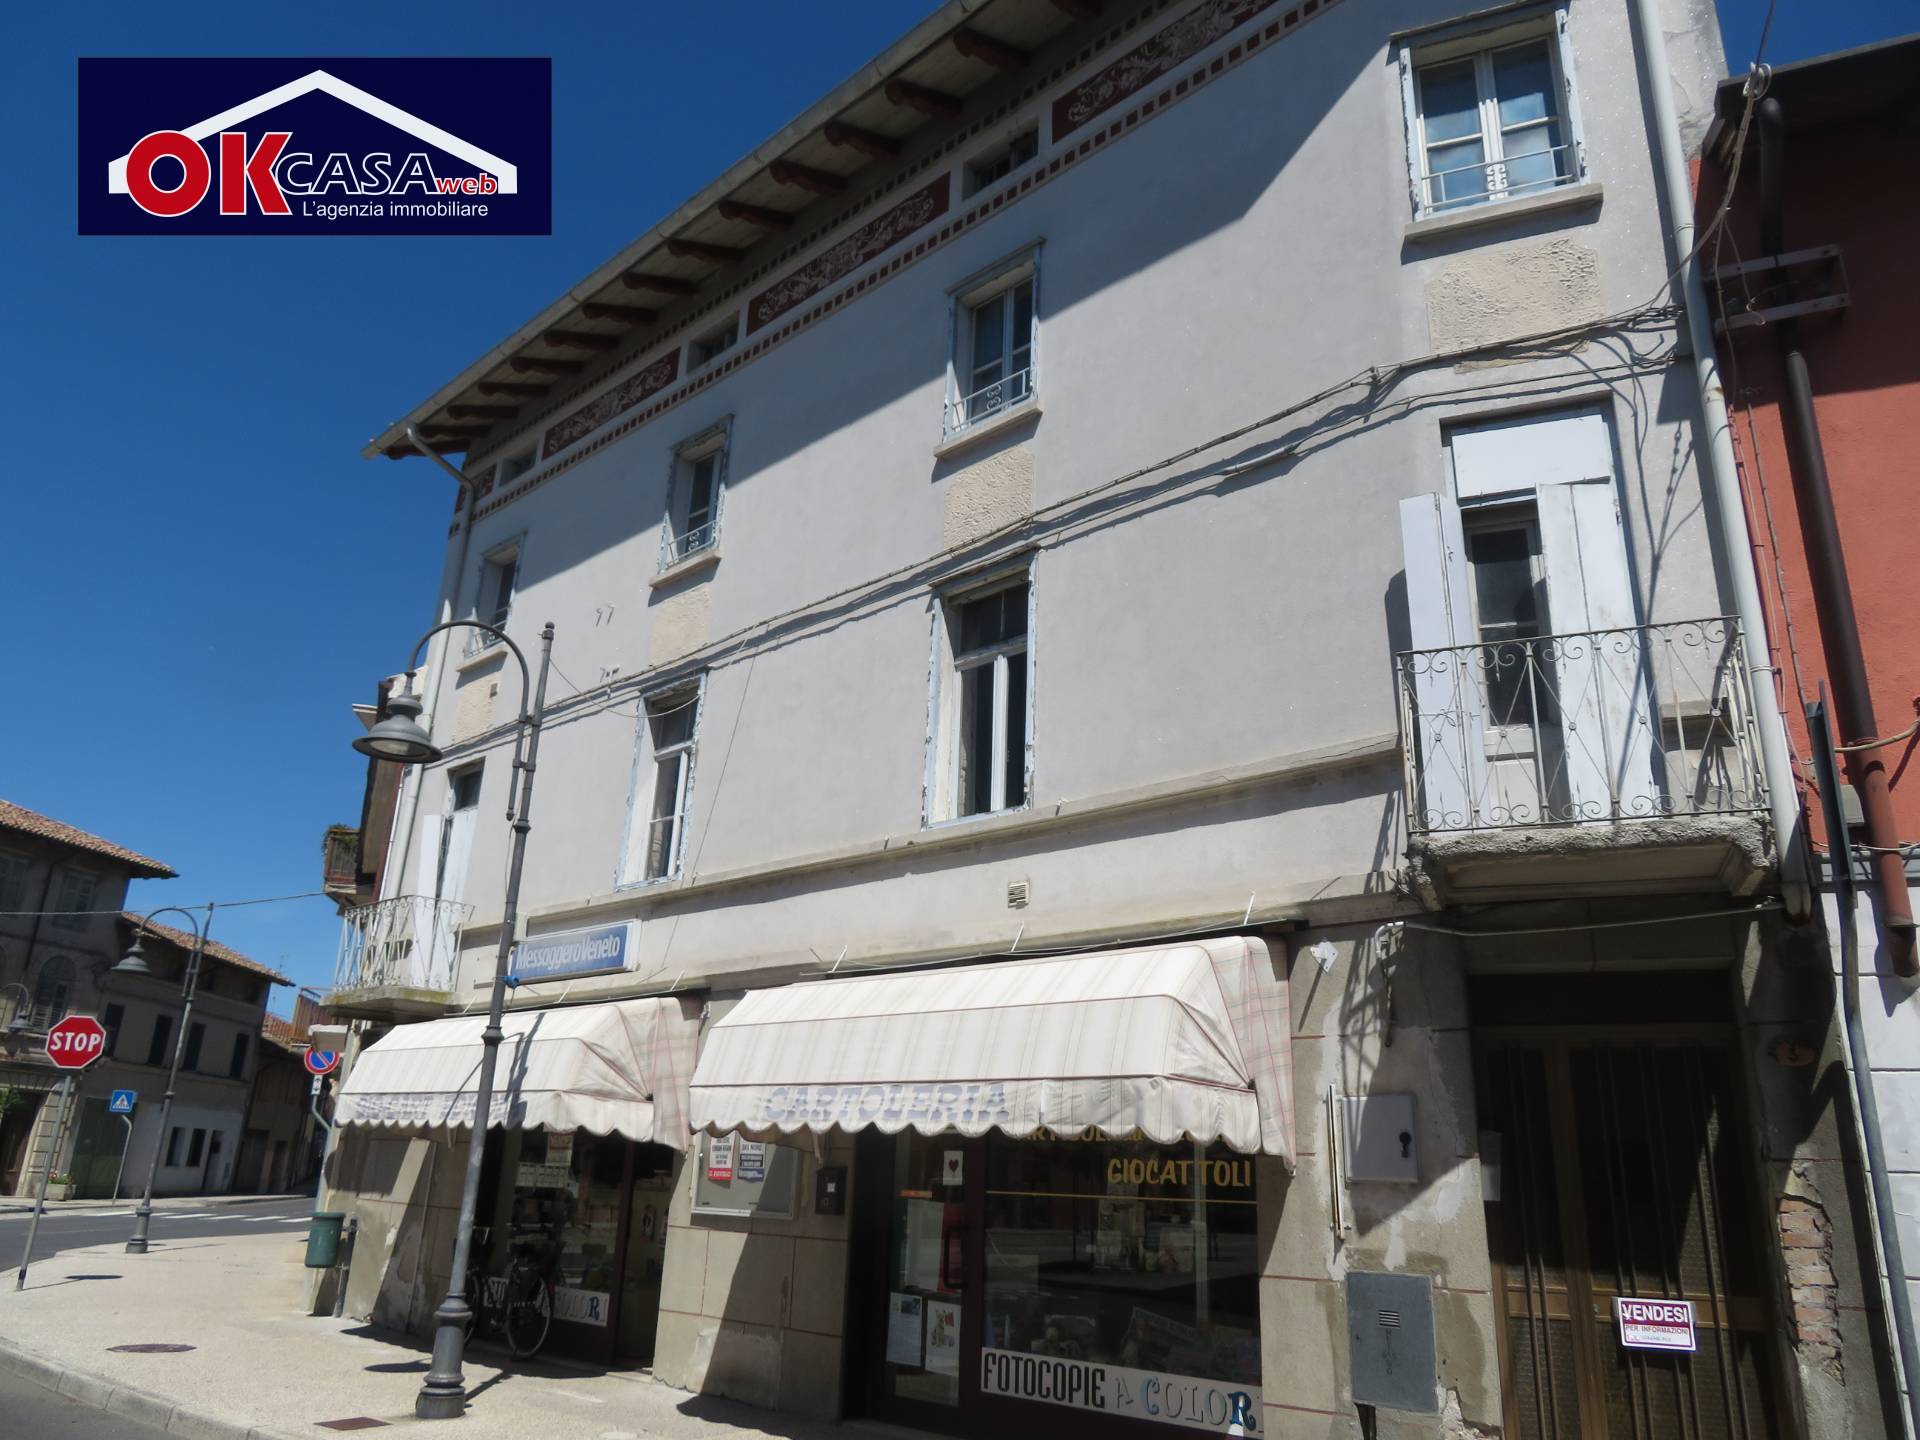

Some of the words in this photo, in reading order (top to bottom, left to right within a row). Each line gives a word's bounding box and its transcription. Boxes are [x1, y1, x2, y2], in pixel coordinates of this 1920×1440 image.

[50, 1032, 101, 1053] STOP
[766, 1084, 1010, 1121] CARTOLERIA
[1107, 1158, 1251, 1187] GIOCATTOLI
[1621, 1303, 1689, 1323] VENDESI
[983, 1352, 1106, 1409] FOTOCOPIE
[1138, 1375, 1263, 1433] COLOR
